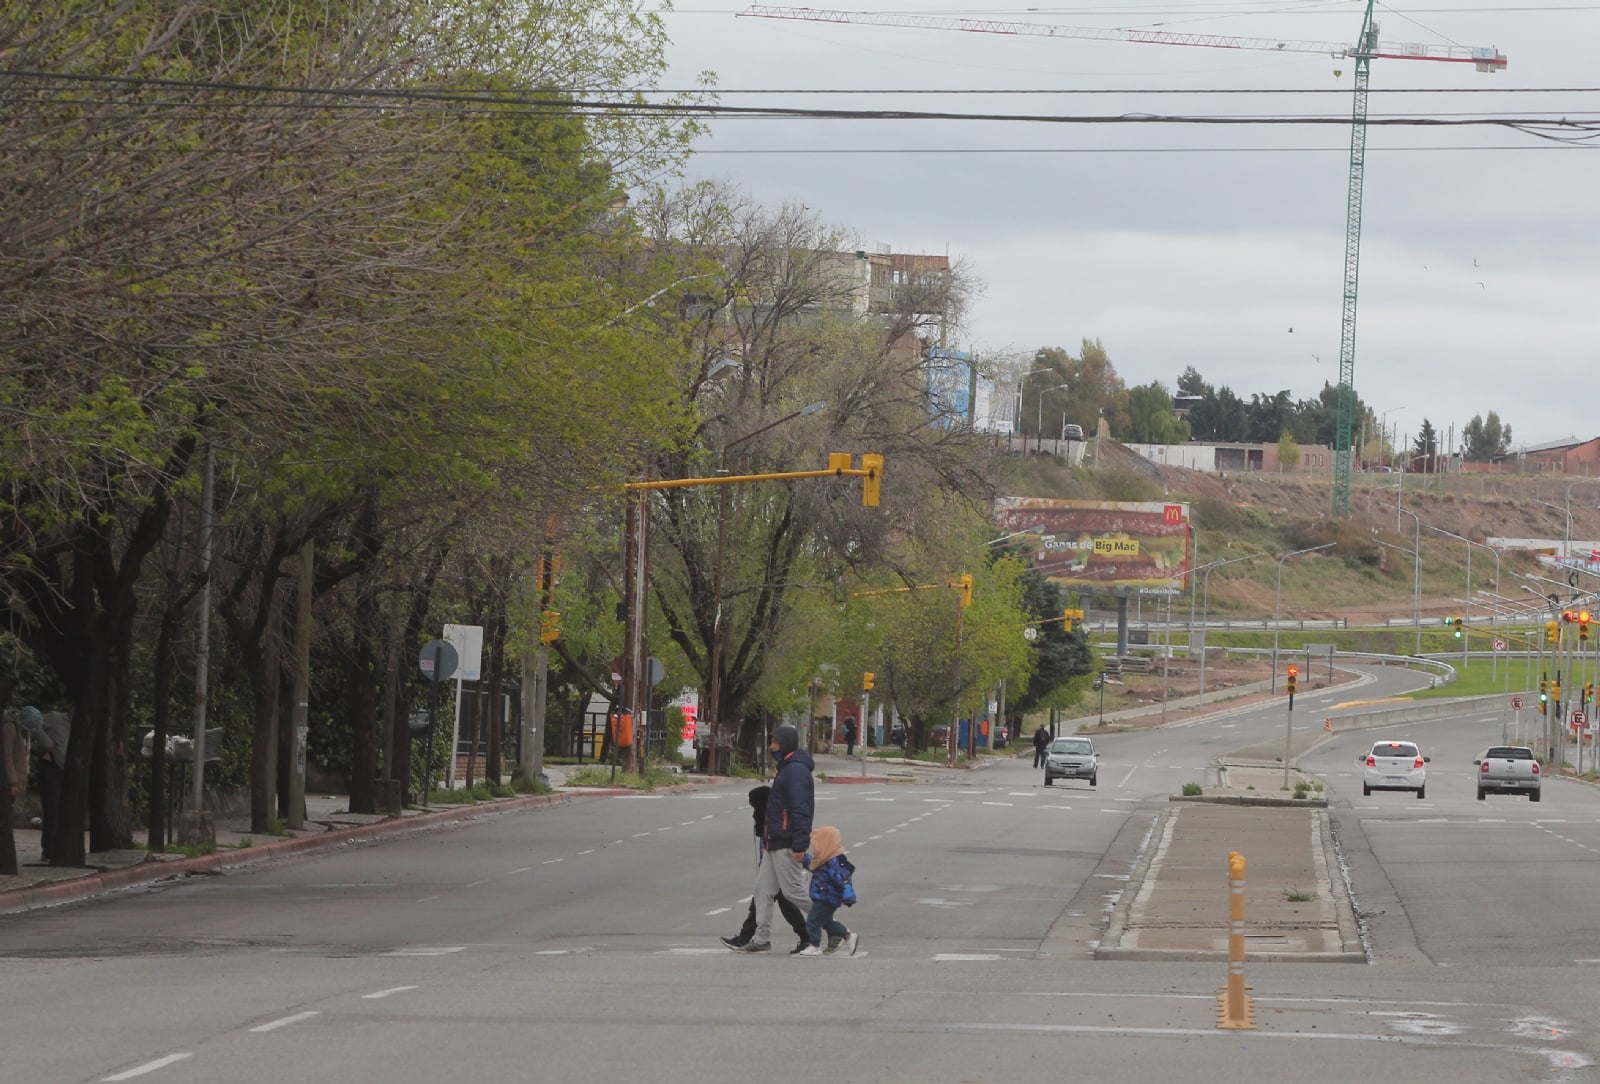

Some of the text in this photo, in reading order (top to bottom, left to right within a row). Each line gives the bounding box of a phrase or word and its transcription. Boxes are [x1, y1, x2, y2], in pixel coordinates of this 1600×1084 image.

[1079, 541, 1092, 550] de
[1095, 541, 1112, 552] Big
[1114, 542, 1136, 551] Mac
[1574, 713, 1583, 723] E
